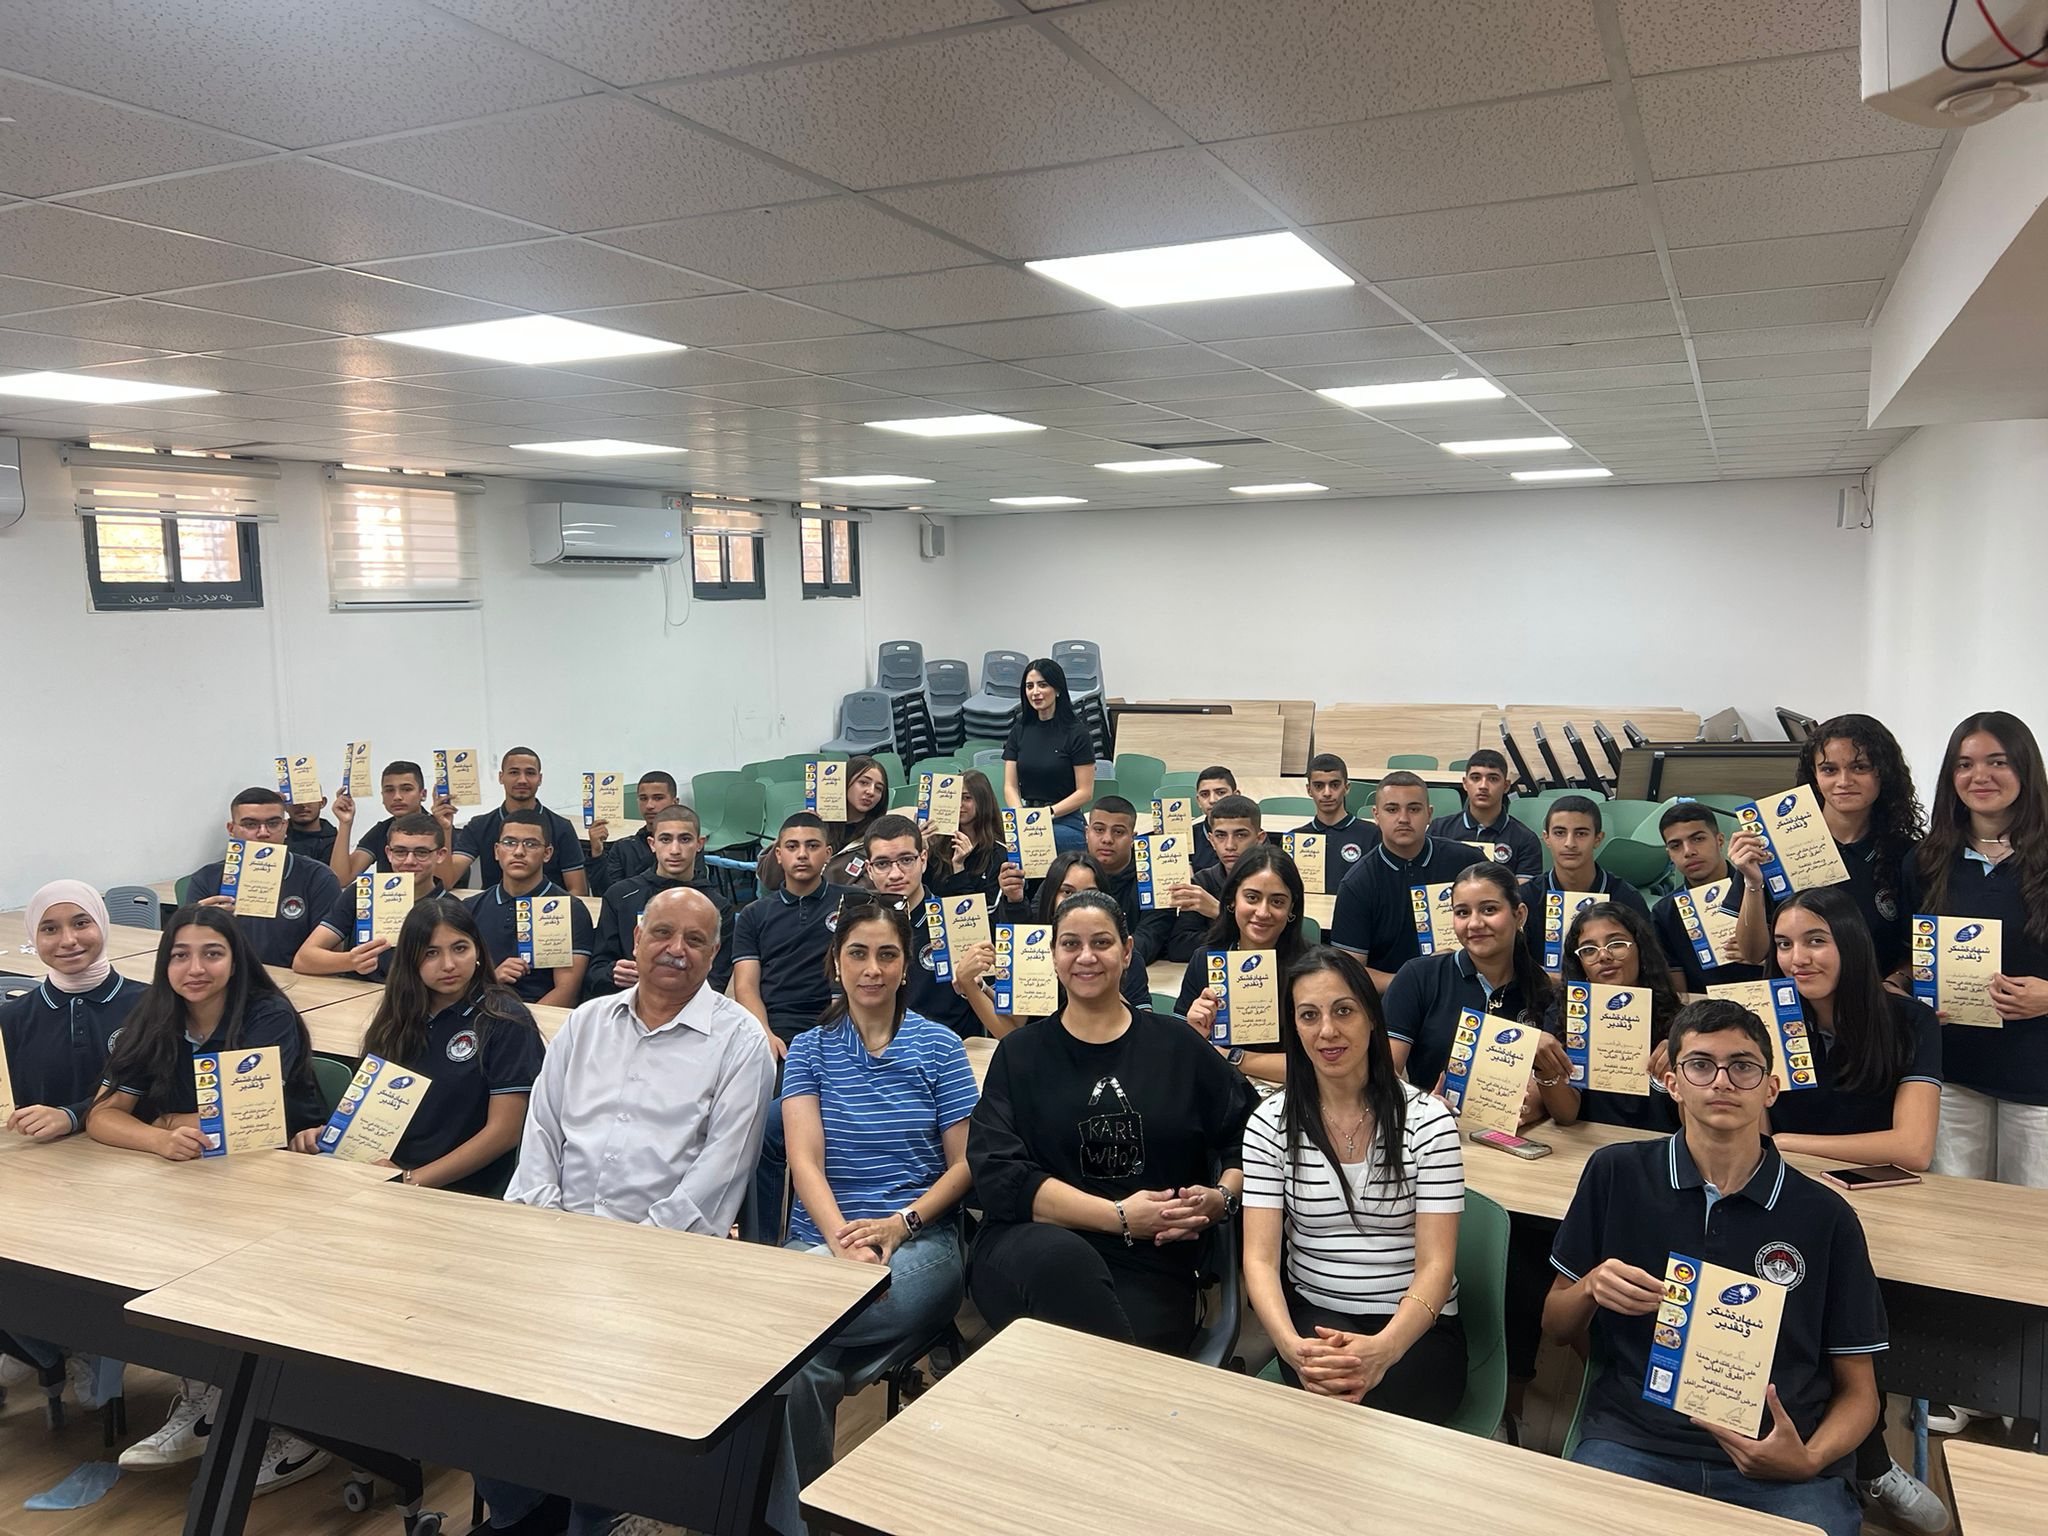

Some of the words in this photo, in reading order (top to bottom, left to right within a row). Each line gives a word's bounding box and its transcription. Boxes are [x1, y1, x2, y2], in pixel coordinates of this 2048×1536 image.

[1089, 1120, 1139, 1140] KARL
[1706, 1307, 1731, 1319] شكر
[1729, 1311, 1763, 1329] شهادة
[1714, 1321, 1751, 1338] وتقدير
